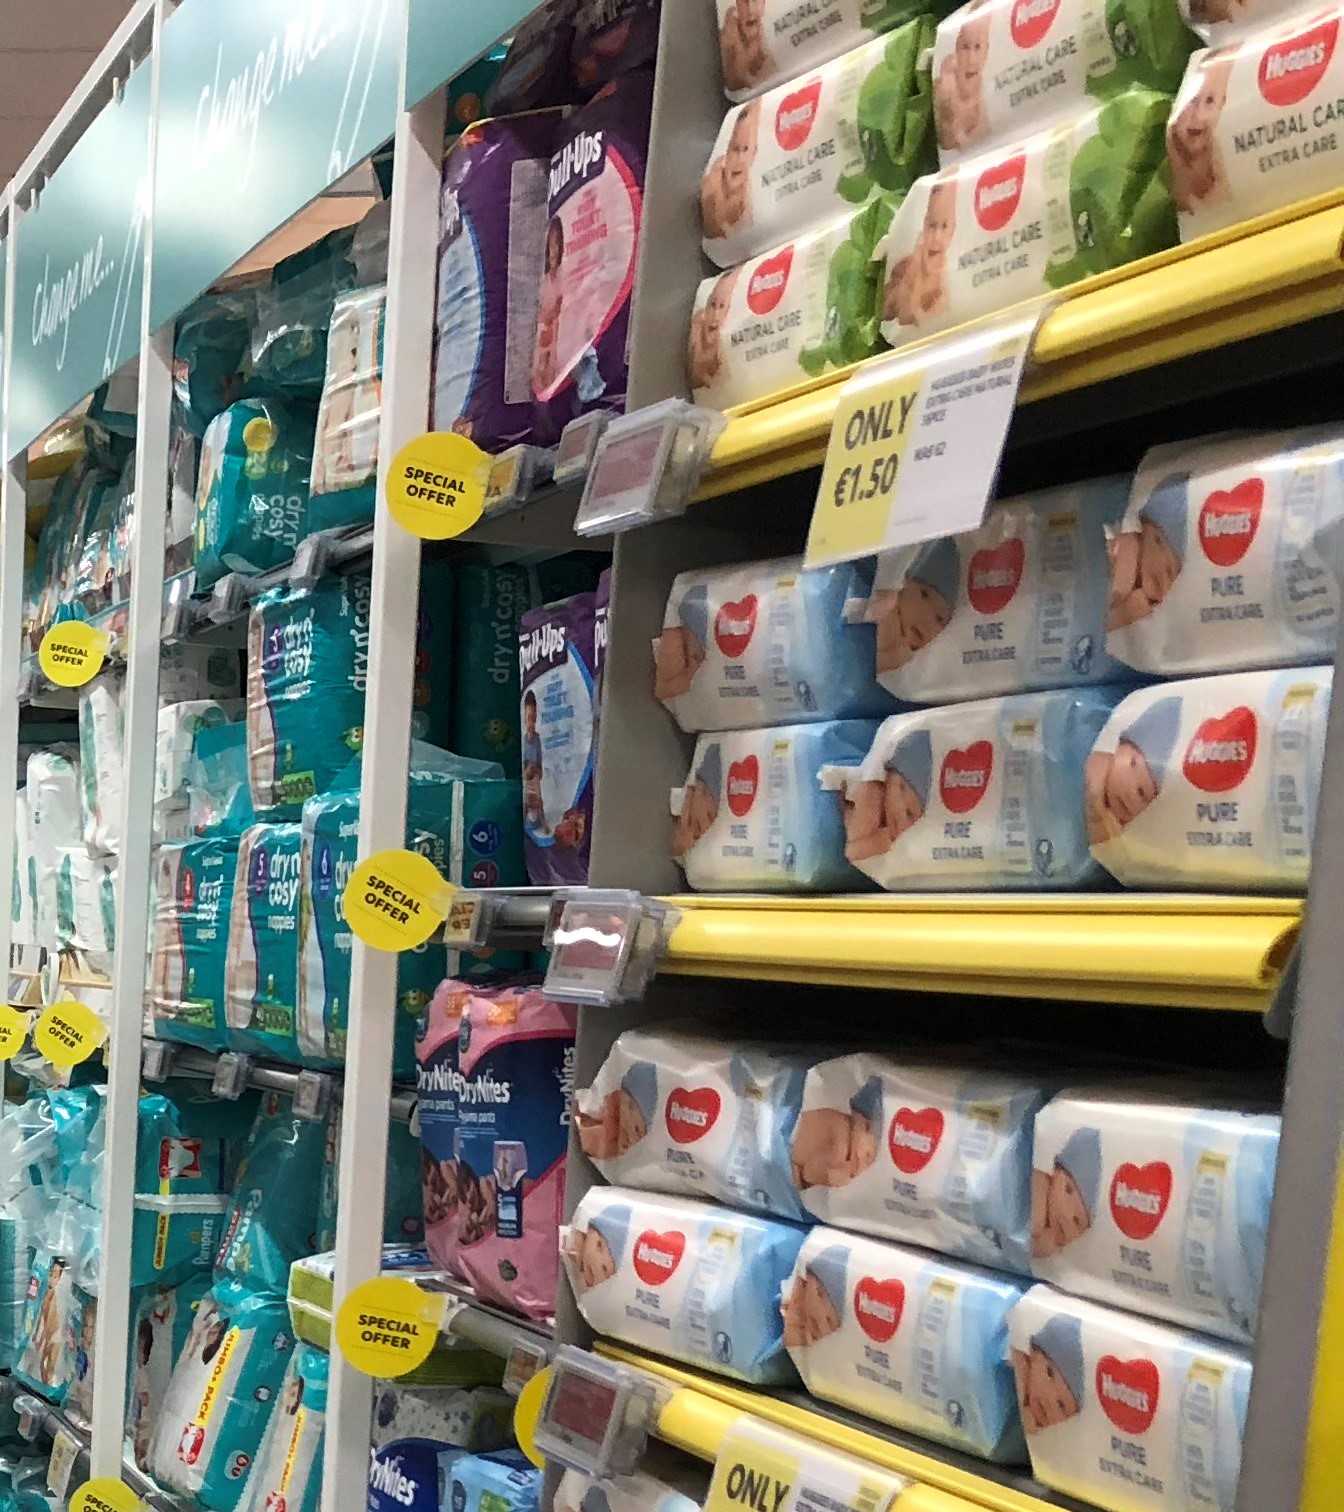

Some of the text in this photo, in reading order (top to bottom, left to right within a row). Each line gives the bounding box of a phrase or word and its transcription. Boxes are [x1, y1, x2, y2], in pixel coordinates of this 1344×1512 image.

[1234, 115, 1306, 152] NATURAL
[1259, 132, 1339, 172] EXTRA CARE
[730, 321, 772, 350] NATURAL
[844, 392, 918, 450] ONLY
[404, 465, 466, 494] SPECIAL
[834, 453, 898, 507] €1.50
[406, 483, 457, 508] OFFER
[1211, 577, 1245, 597] PURE
[50, 642, 89, 658] SPECIAL
[52, 654, 83, 667] OFFER
[1196, 802, 1239, 822] PURE
[944, 821, 973, 839] PURE
[364, 893, 411, 925] OFFER
[366, 875, 421, 915] SPECIAL
[48, 1027, 77, 1049] OFFER
[50, 1014, 84, 1044] SPECIAL
[459, 1074, 511, 1104] DryNites
[358, 1313, 420, 1338] SPECIAL
[361, 1329, 411, 1350] OFFER
[1112, 1437, 1147, 1467] PURE
